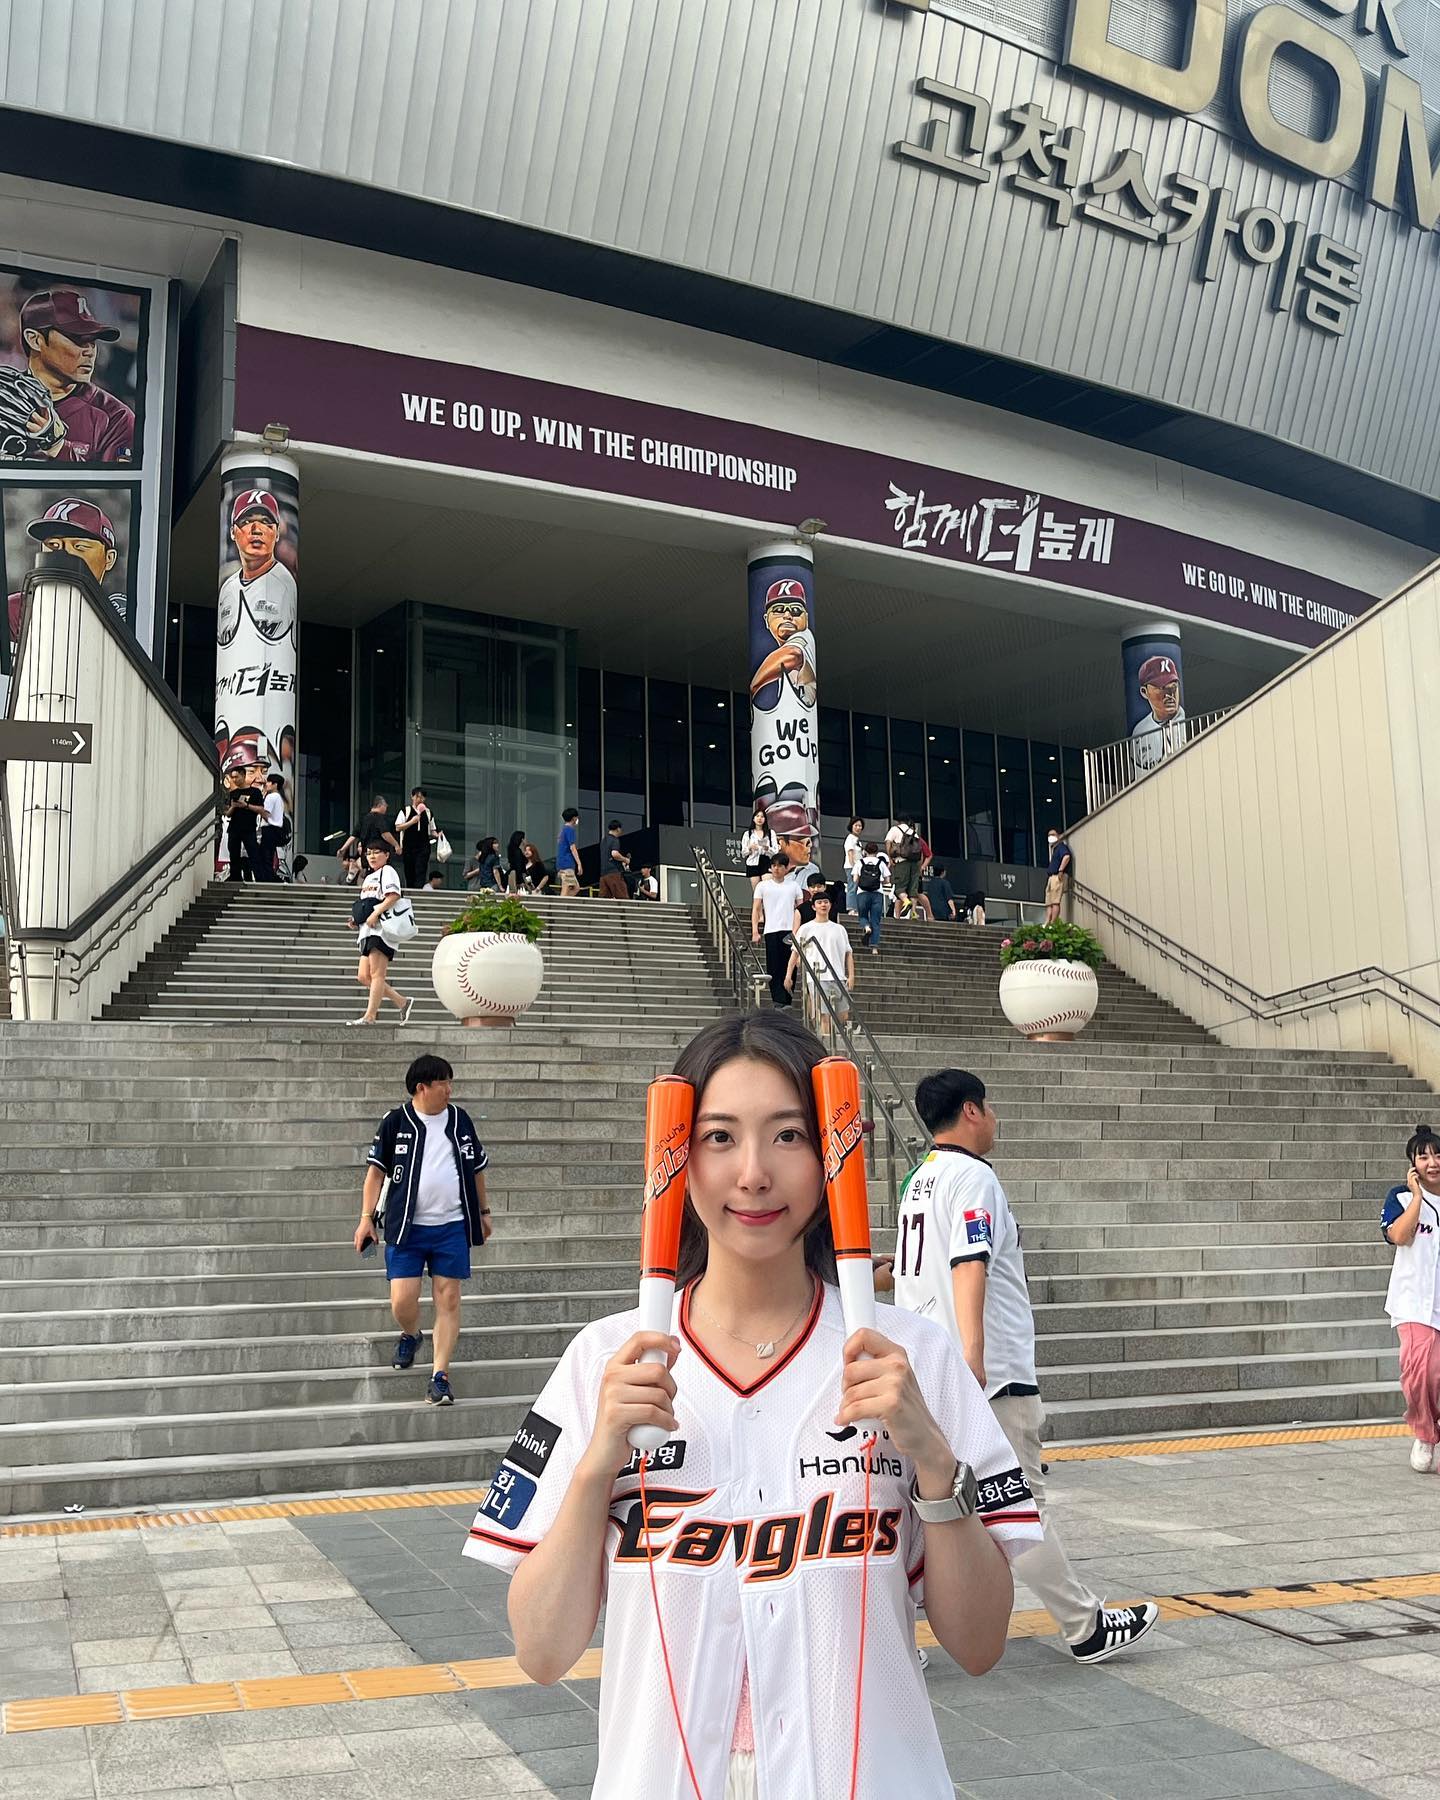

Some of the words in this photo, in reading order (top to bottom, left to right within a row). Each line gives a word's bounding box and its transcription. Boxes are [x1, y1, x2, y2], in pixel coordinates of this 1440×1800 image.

[894, 76, 1363, 337] 고척스카이돔
[401, 392, 446, 426] WE
[452, 401, 485, 432] GO
[532, 415, 583, 451] WIN
[588, 427, 635, 461] THE
[641, 437, 797, 492] CHAMPIONSHIP
[1182, 562, 1206, 589] WE
[1208, 570, 1227, 595] GO
[1249, 582, 1278, 610] WIN
[1279, 591, 1305, 618] THE
[51, 738, 73, 746] 1140m
[776, 717, 809, 742] We
[759, 744, 791, 767] Go
[796, 736, 818, 764] Up
[393, 1164, 404, 1183] 8
[901, 1212, 925, 1276] 17
[514, 1428, 548, 1459] think
[800, 1452, 903, 1478] Hanwha
[609, 1486, 903, 1584] Eagles
